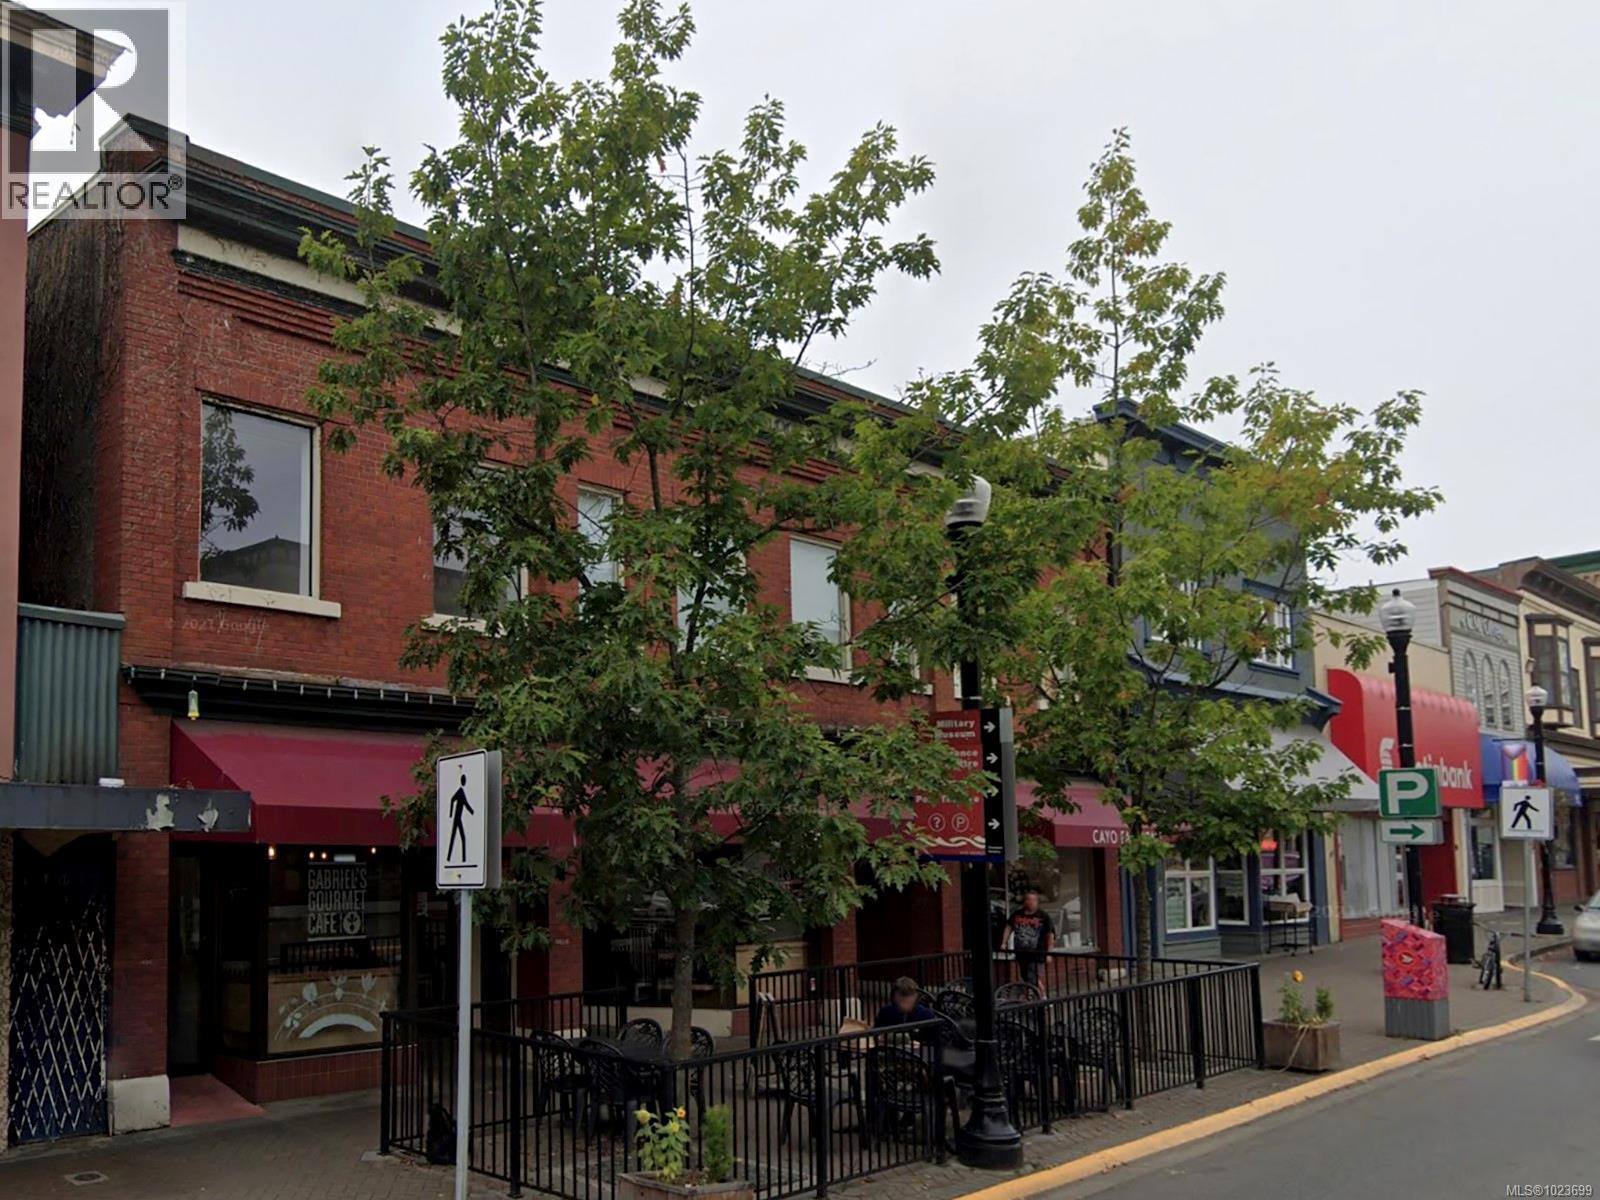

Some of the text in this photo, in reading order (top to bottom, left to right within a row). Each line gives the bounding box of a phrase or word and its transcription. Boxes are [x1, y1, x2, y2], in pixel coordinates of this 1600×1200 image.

[936, 719, 976, 729] Military
[1386, 771, 1429, 815] P
[1092, 829, 1119, 844] CAYO
[307, 867, 368, 890] GABRIEL'S
[307, 889, 367, 911] GOURMET
[307, 912, 338, 934] CAFE
